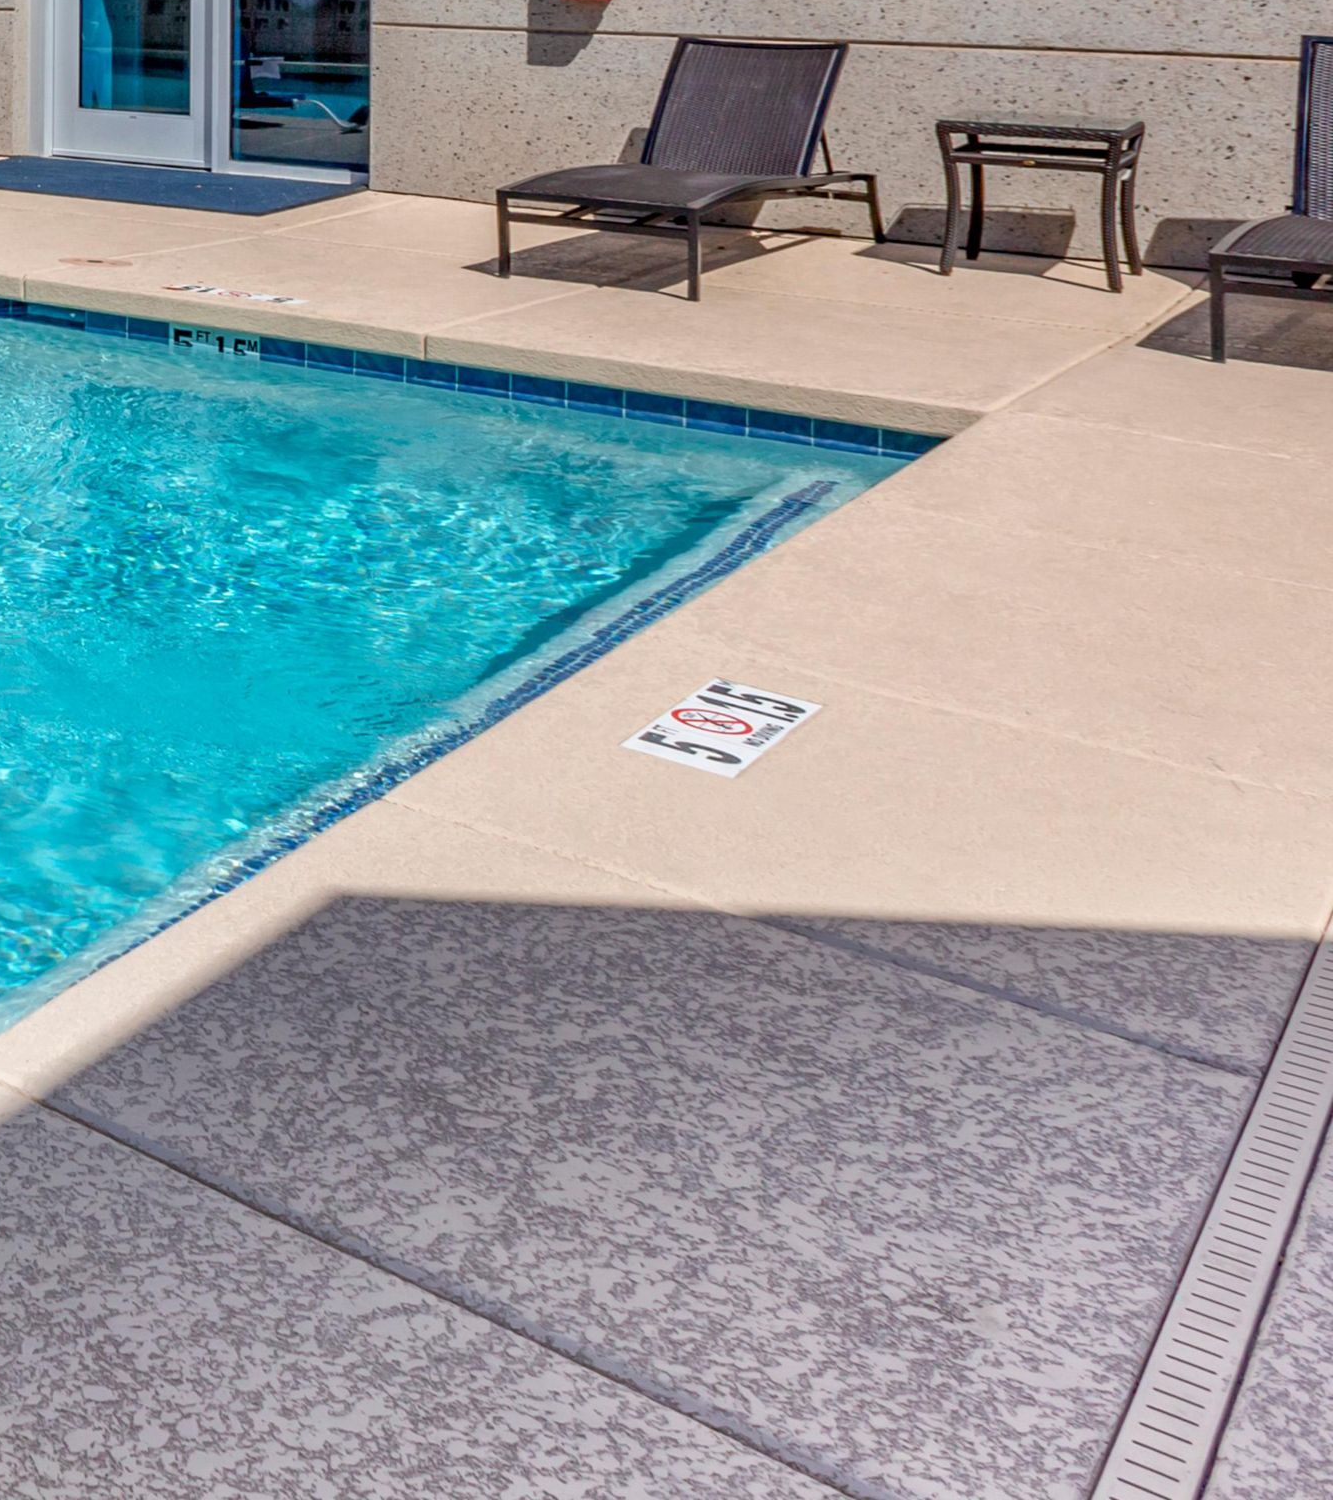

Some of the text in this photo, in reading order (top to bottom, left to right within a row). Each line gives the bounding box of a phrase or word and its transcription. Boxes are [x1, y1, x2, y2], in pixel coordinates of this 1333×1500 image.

[196, 330, 211, 344] FT
[248, 340, 258, 353] M
[695, 684, 807, 723] 1.5
[752, 723, 785, 741] DIVING
[637, 731, 743, 765] 5
